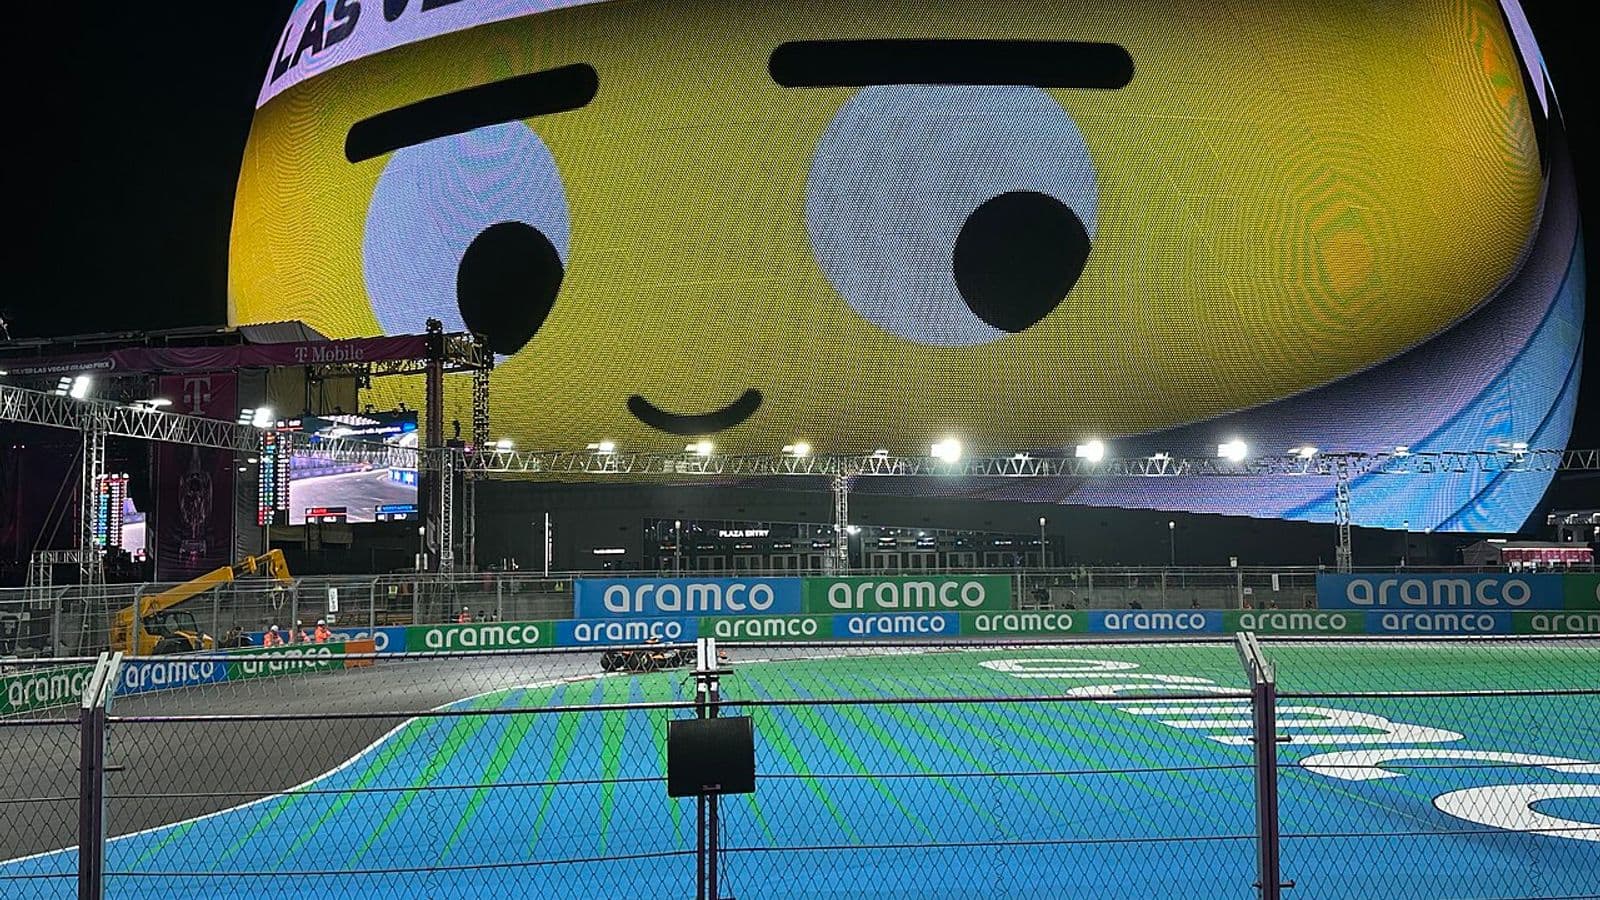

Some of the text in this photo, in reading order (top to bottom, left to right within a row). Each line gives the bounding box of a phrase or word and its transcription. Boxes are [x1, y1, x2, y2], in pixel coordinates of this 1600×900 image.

[270, 0, 361, 86] LAS
[311, 345, 363, 361] Mobile
[48, 365, 69, 373] VEGAS
[745, 529, 769, 537] ENTRY
[604, 584, 774, 612] aramco
[828, 581, 985, 608] aramco
[1347, 579, 1531, 606] aramco
[715, 619, 817, 637] aramco
[849, 616, 945, 633] aramco
[975, 613, 1073, 631] aramco
[1104, 614, 1205, 629] aramco
[1240, 613, 1346, 630] aramco
[1383, 614, 1494, 630] aramco
[425, 626, 539, 648] aramco
[574, 622, 681, 641] aramco
[243, 647, 331, 673] aramco
[126, 662, 213, 687] aramco
